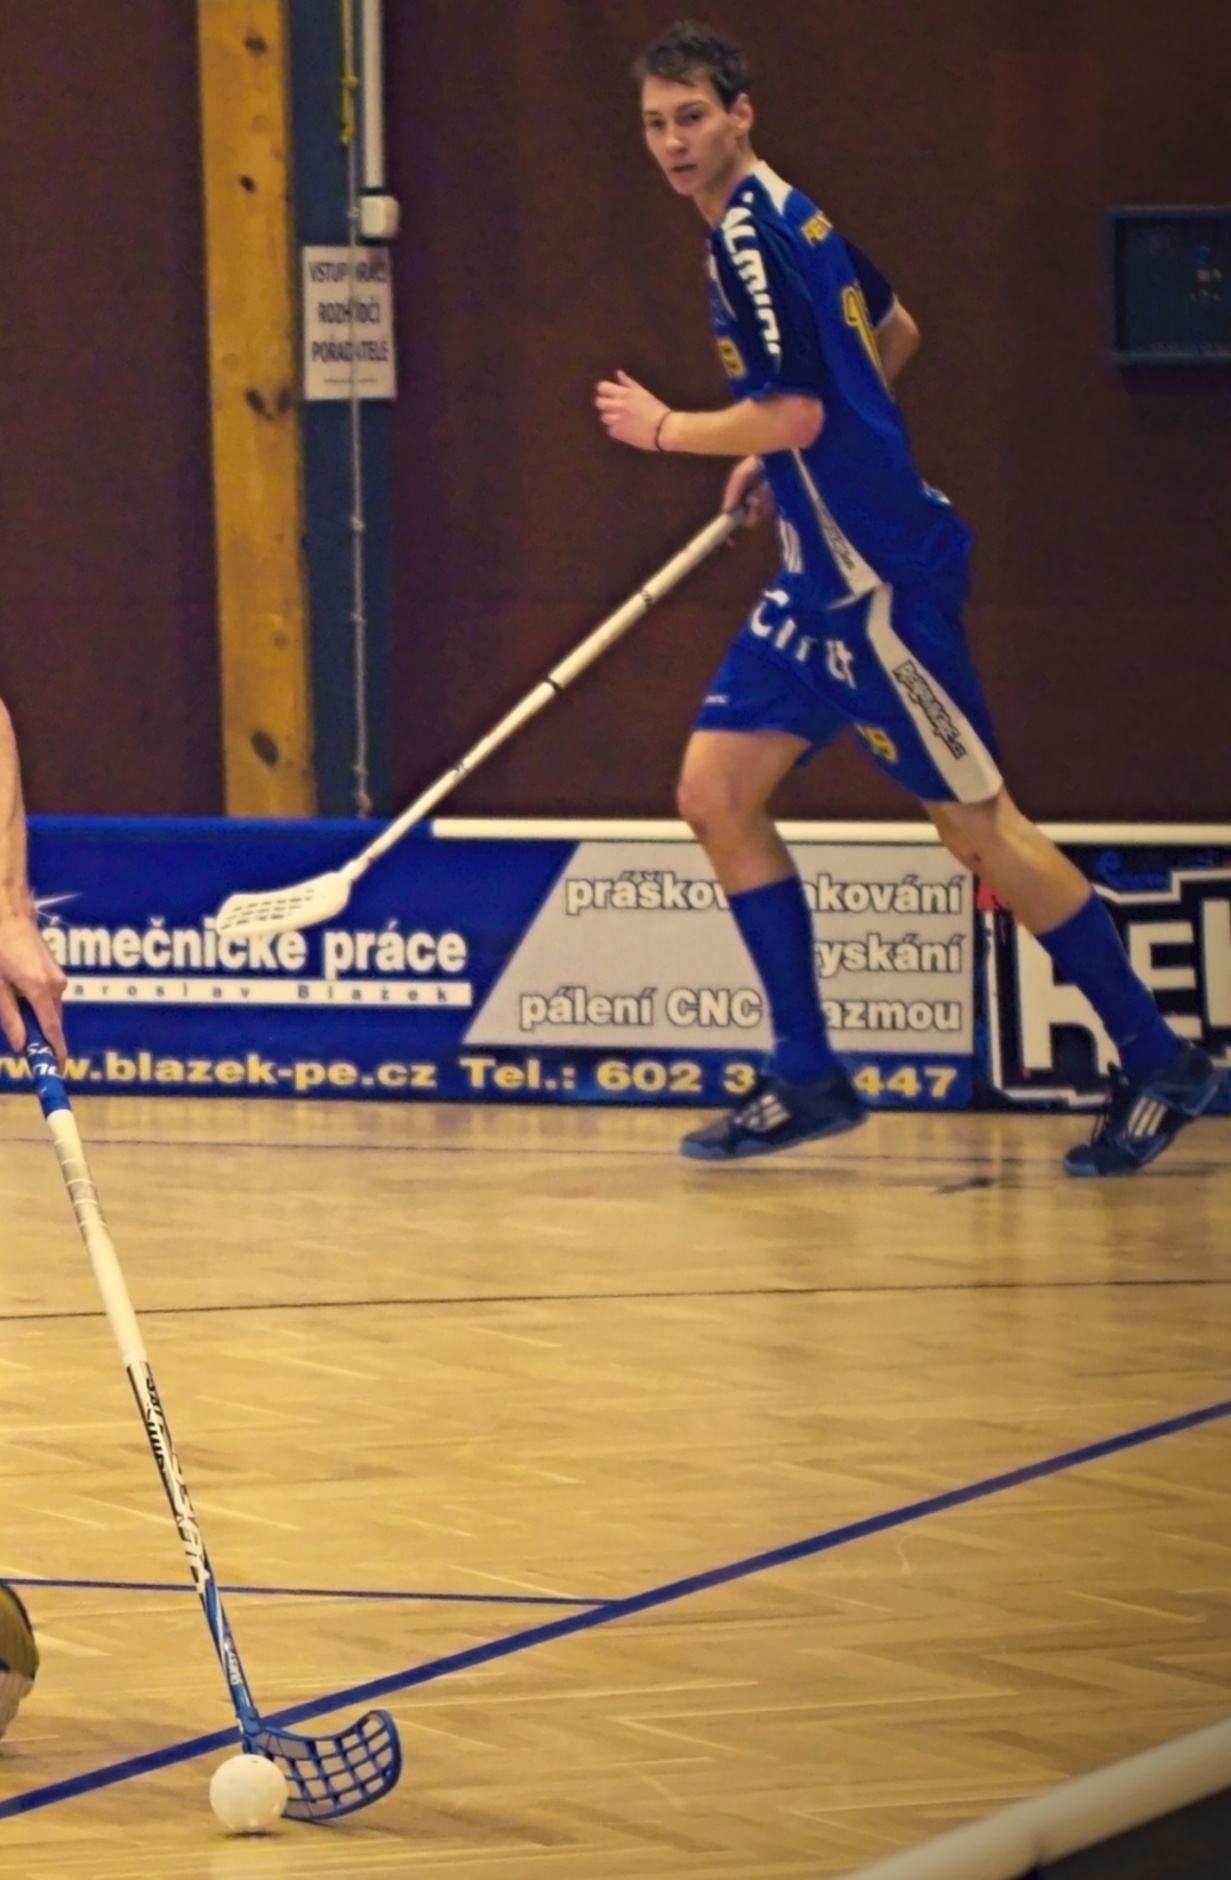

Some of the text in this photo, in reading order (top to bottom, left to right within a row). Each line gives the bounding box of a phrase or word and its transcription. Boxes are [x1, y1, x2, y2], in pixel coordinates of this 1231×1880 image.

[324, 919, 468, 981] práce
[816, 931, 966, 979] yskání
[73, 982, 450, 1002] aroslav Blažek
[519, 984, 963, 1032] pálení CNC azmou
[459, 1057, 576, 1090] Tel.:
[596, 1059, 703, 1093] 602
[853, 1065, 958, 1098] 447
